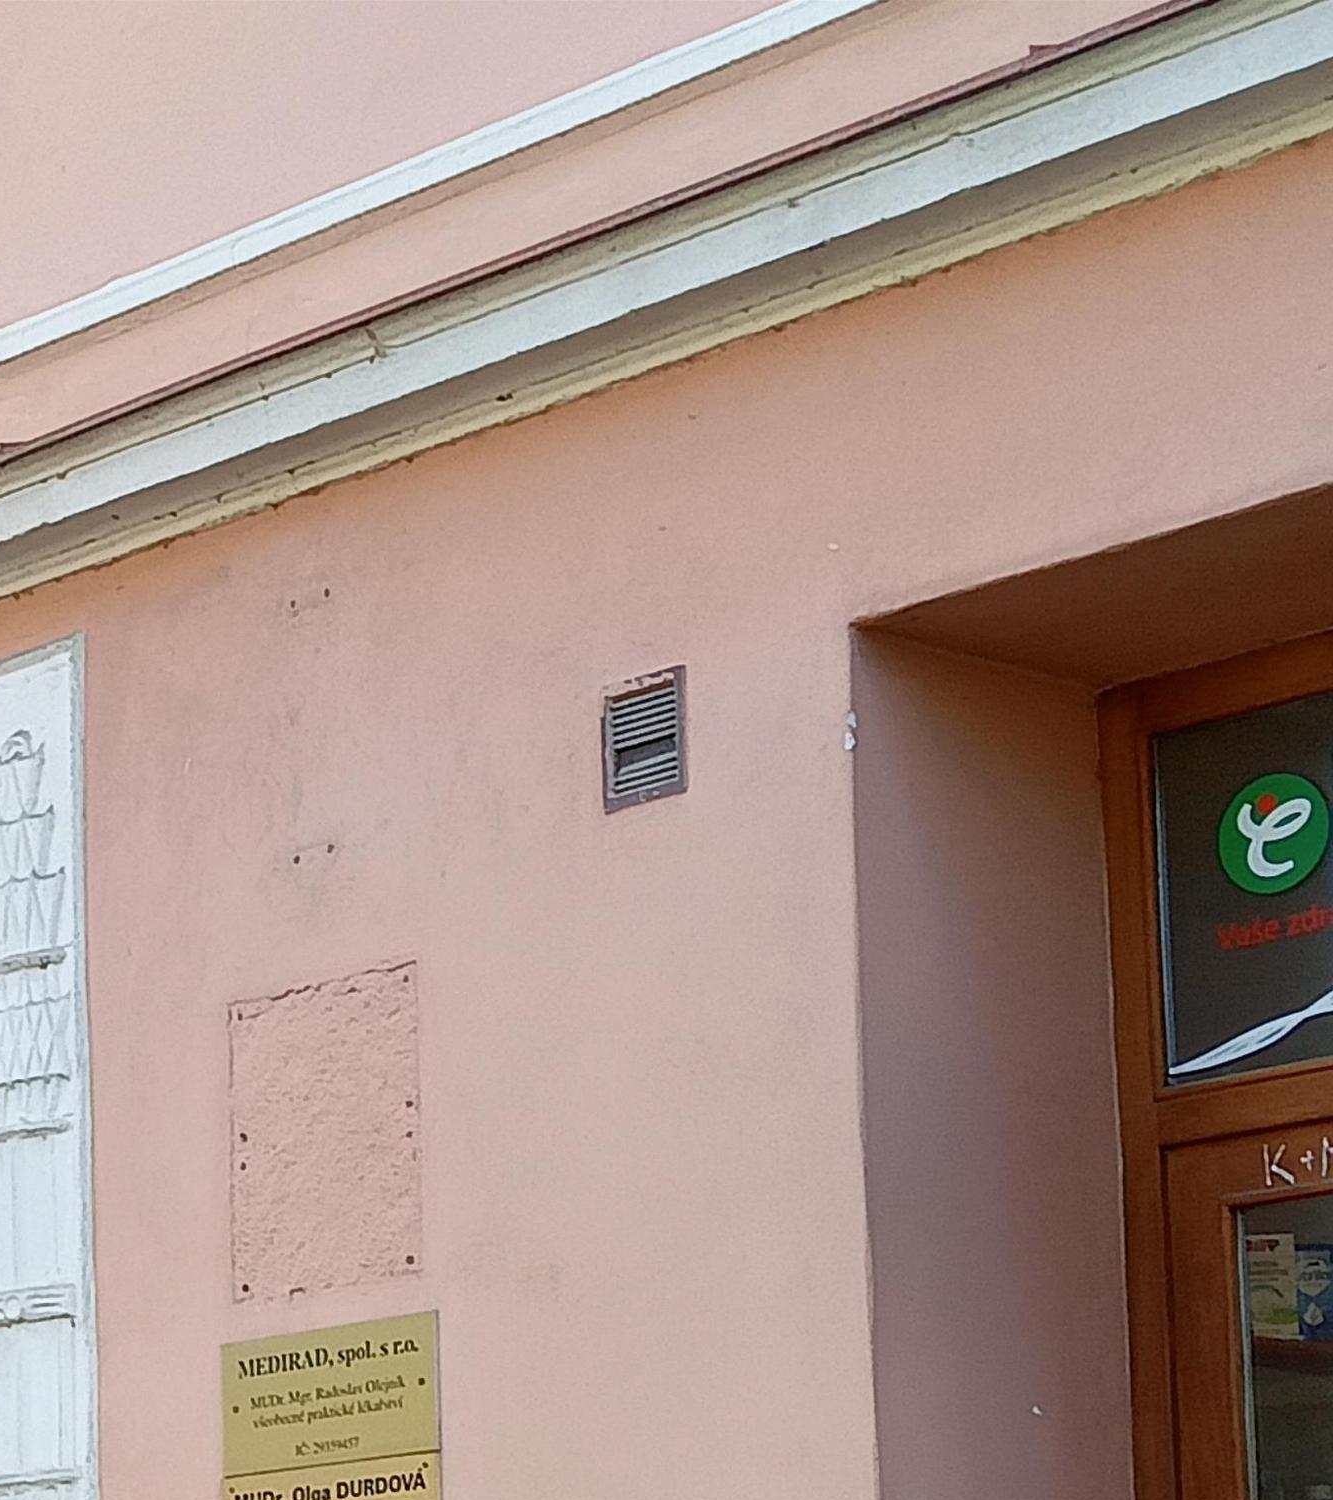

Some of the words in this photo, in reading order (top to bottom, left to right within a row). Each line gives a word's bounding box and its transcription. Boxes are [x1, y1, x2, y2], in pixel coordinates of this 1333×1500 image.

[238, 1347, 334, 1380] MEDIRAD,
[336, 1340, 377, 1367] spol.
[379, 1342, 389, 1357] s
[393, 1339, 420, 1355] r.o.
[336, 1467, 426, 1499] DURDOVÁ
